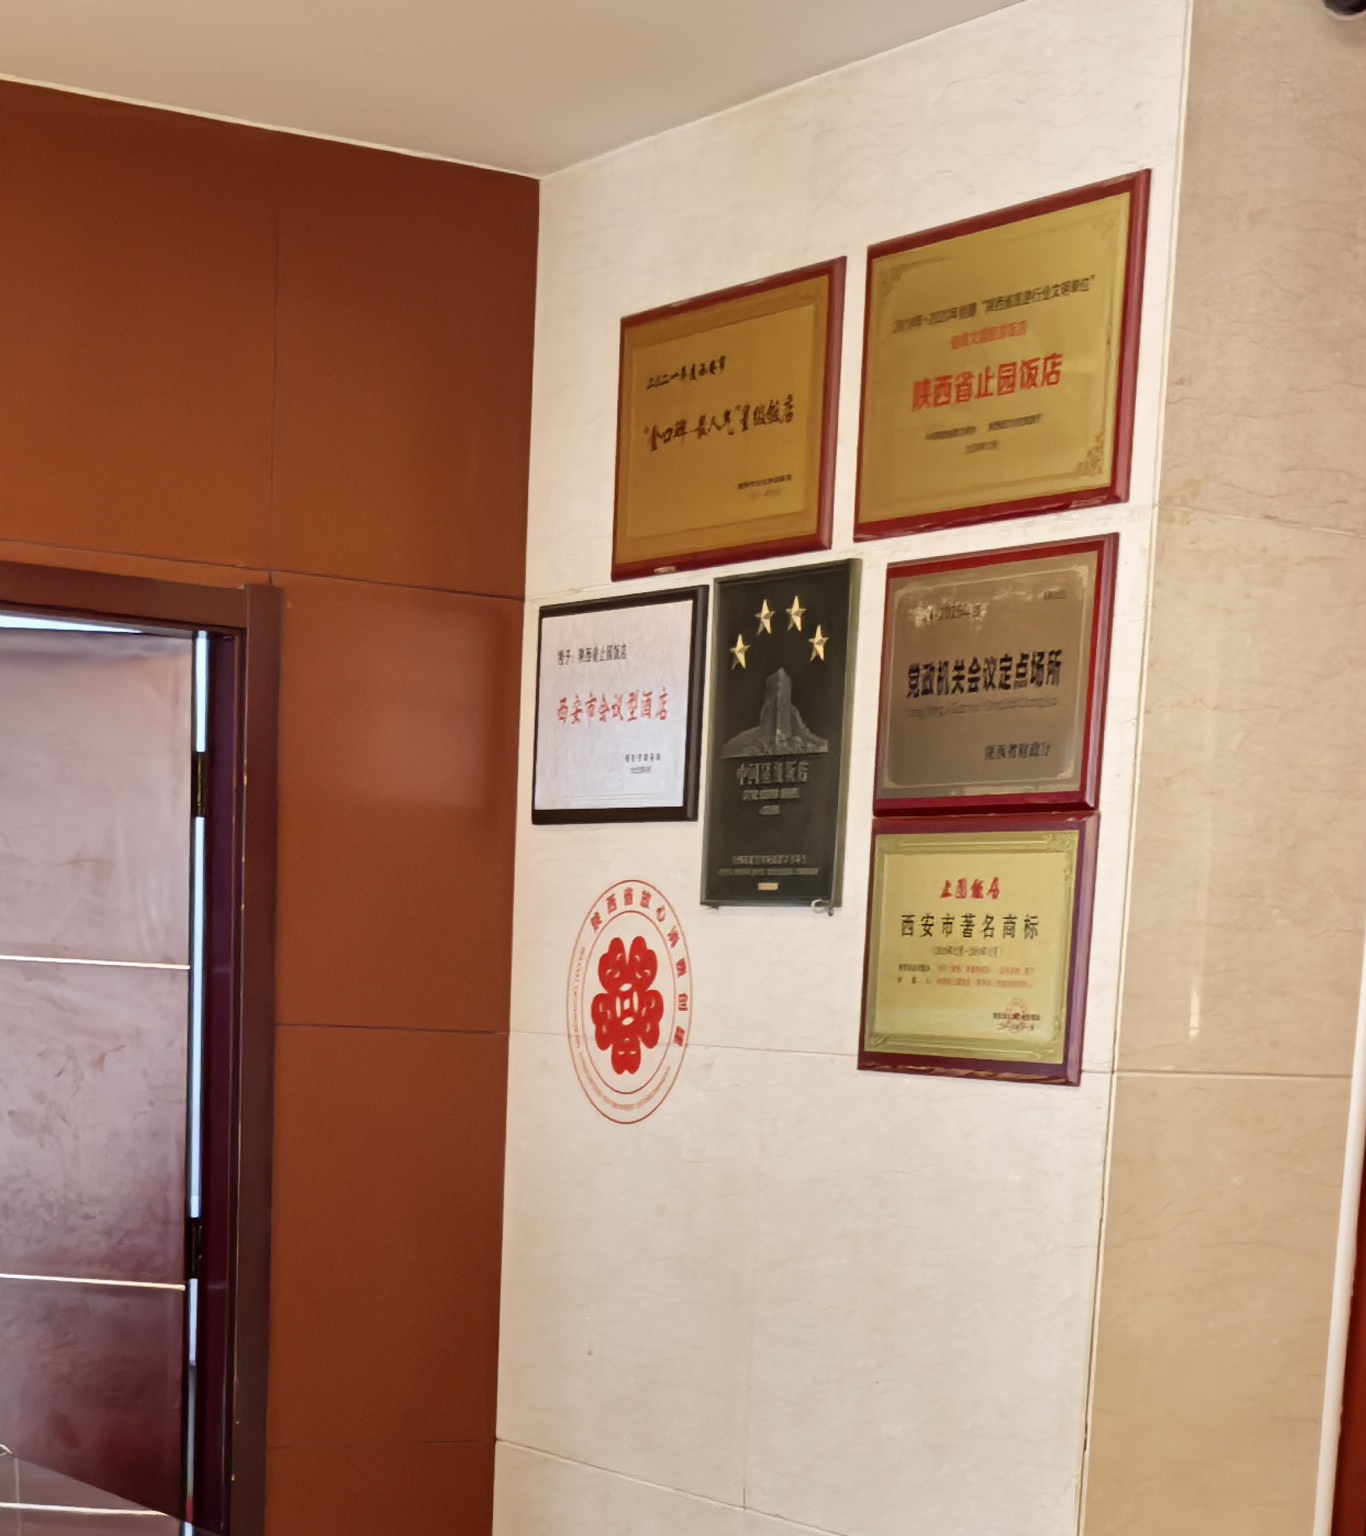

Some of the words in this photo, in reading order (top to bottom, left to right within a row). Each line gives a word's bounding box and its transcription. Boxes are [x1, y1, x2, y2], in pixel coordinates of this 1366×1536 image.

[911, 352, 1063, 412] 陕西省止园饭店
[907, 649, 1063, 699] 党政机关会议定点场所
[900, 912, 1040, 940] 西安市著名商标
